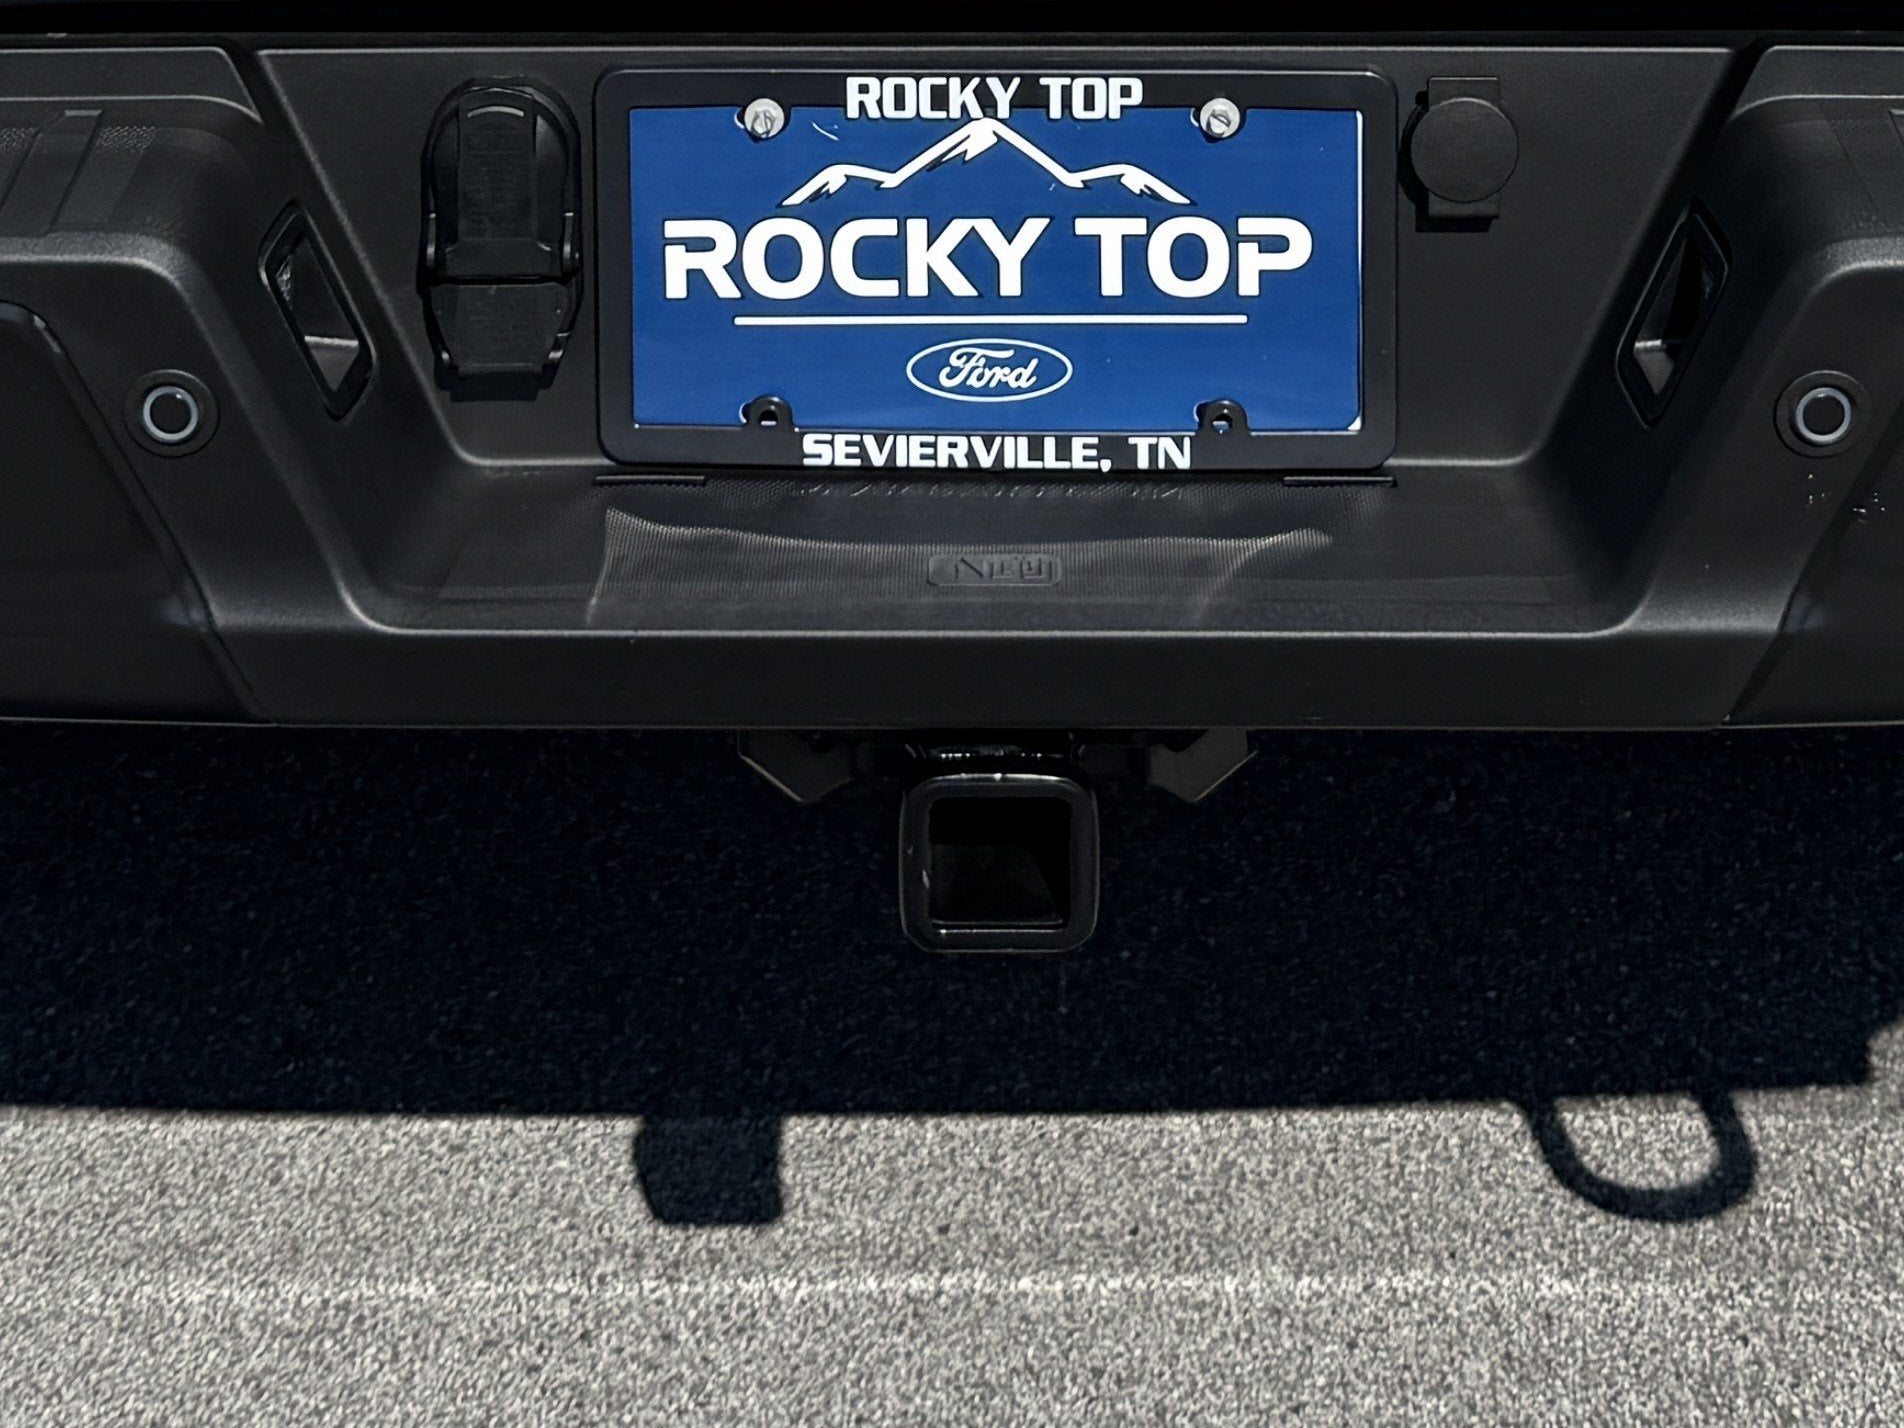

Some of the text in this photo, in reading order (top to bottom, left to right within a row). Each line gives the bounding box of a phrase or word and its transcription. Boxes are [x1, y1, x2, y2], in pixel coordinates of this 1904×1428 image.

[845, 76, 1144, 120] ROCKY TOP
[662, 215, 1314, 300] ROCKY TOP
[938, 345, 1040, 391] Ford
[802, 434, 1193, 473] SEVIERVILLE, TN
